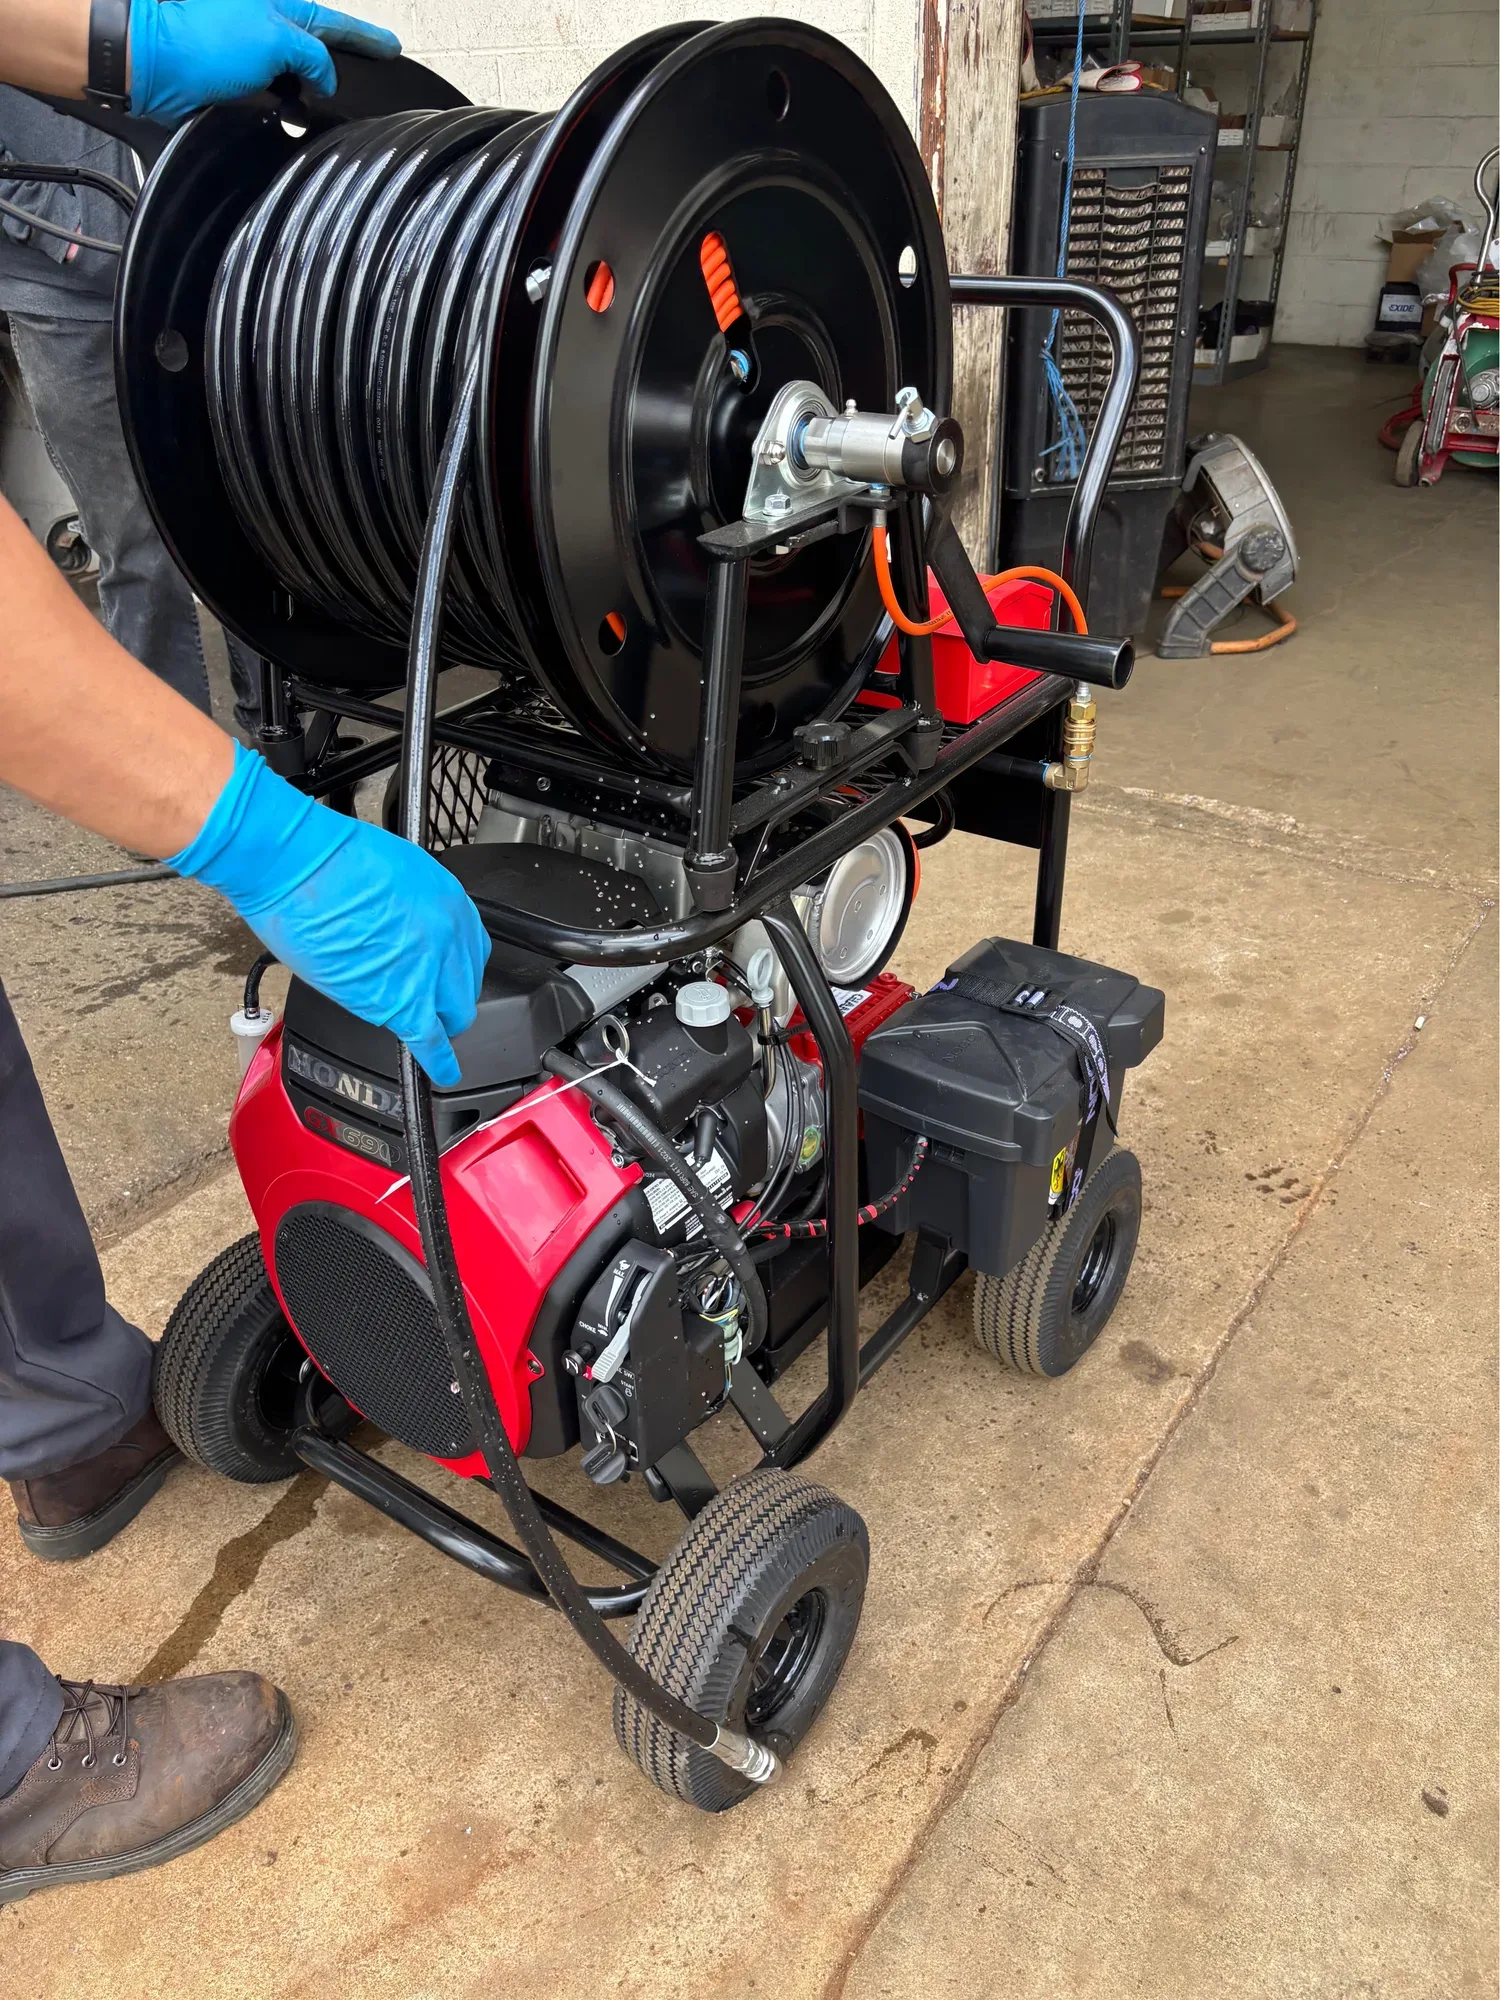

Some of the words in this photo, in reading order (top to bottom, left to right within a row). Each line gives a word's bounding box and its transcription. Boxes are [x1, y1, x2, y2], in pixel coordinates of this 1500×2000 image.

[1388, 304, 1415, 312] EXIDE
[657, 1147, 672, 1163] 2021
[687, 1185, 699, 1198] SAE
[579, 1321, 596, 1334] CHOKE
